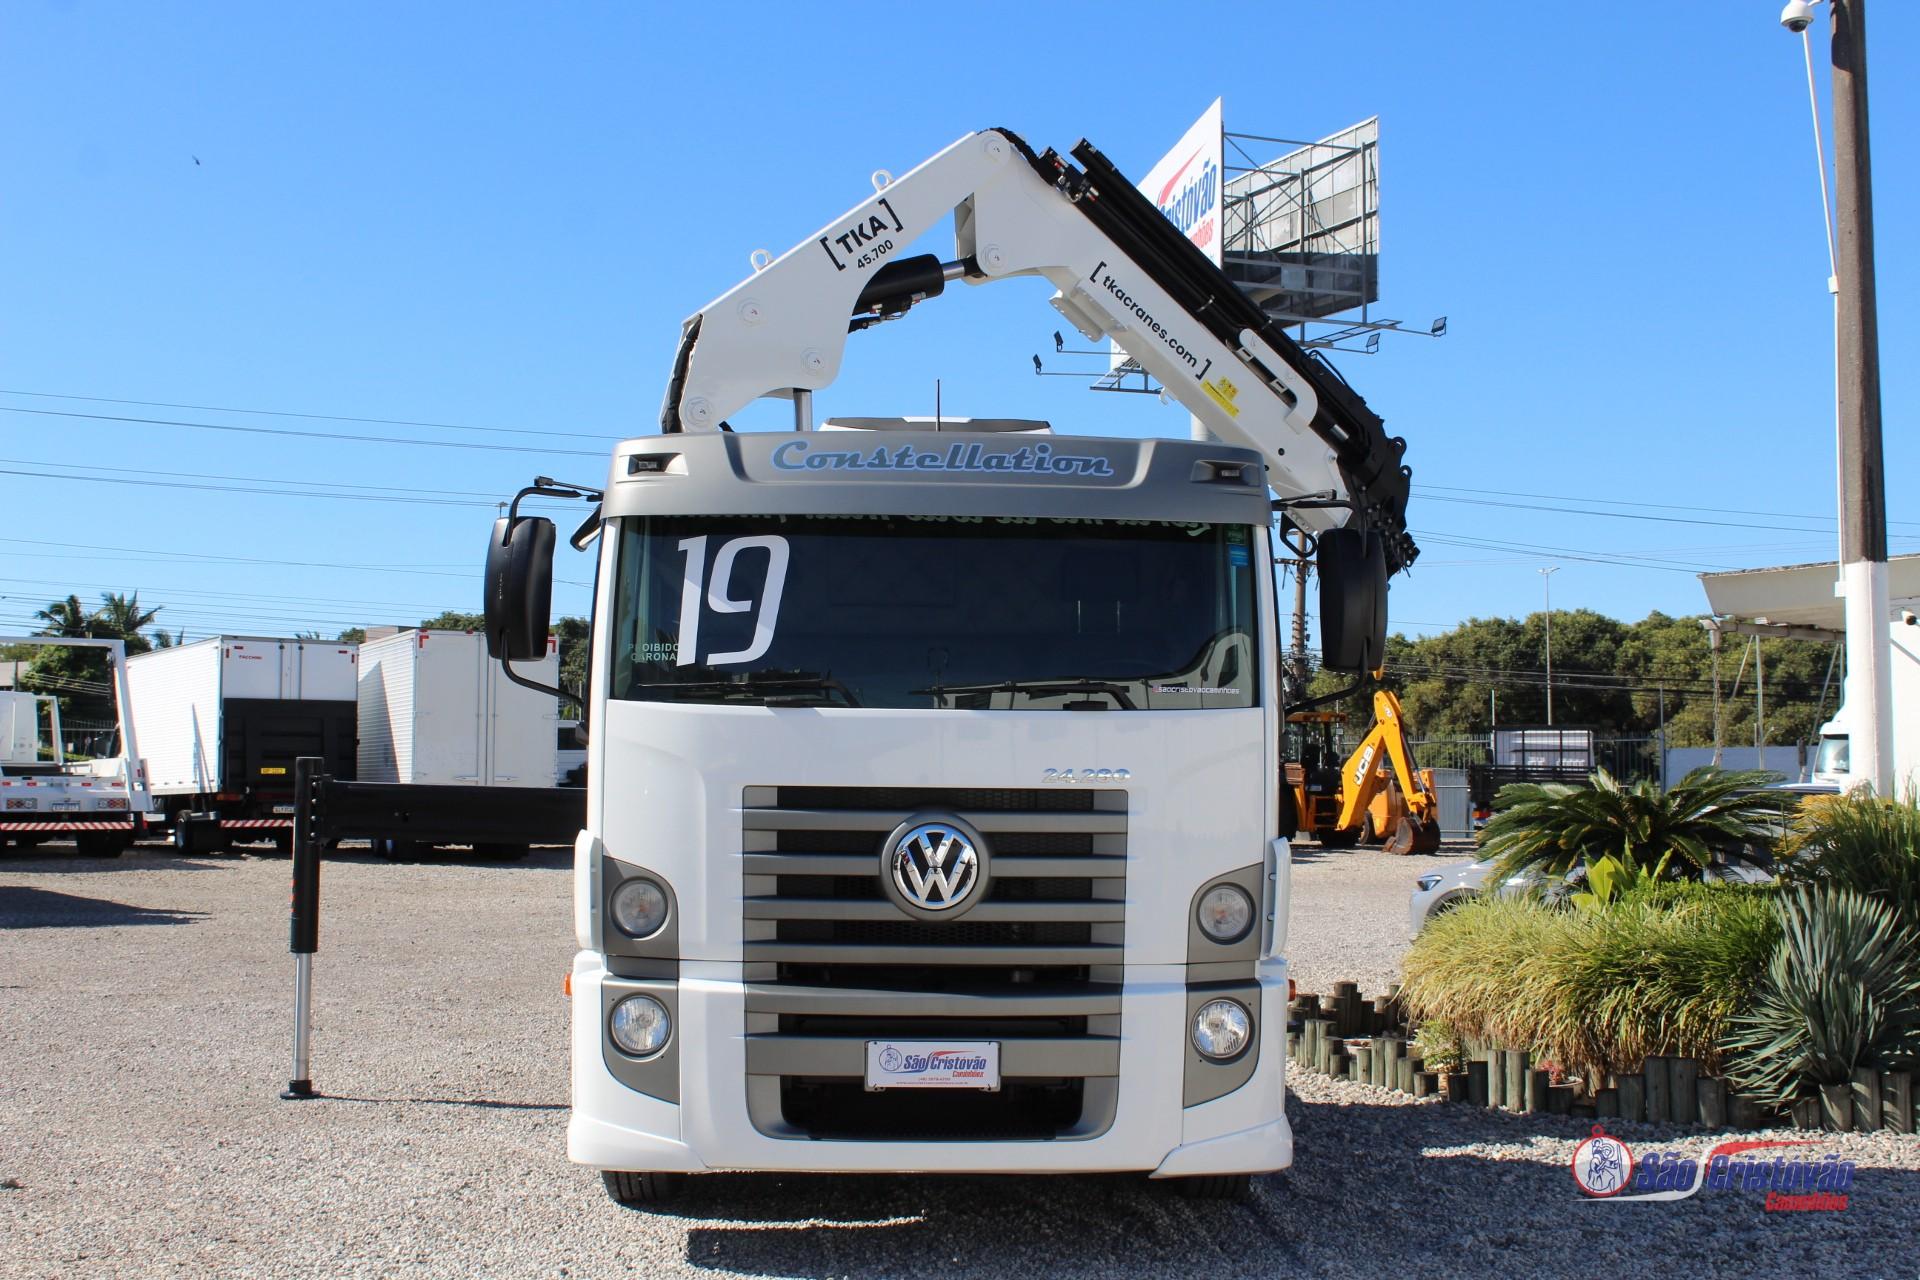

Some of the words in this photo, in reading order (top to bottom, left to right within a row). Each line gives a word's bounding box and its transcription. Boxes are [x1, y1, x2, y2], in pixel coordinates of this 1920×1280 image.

[857, 240, 893, 269] 45.700
[772, 439, 1115, 477] Constellation
[676, 535, 790, 667] 19
[1353, 744, 1375, 786] JCB
[904, 1055, 927, 1070] São
[930, 1055, 987, 1070] Cristóvão
